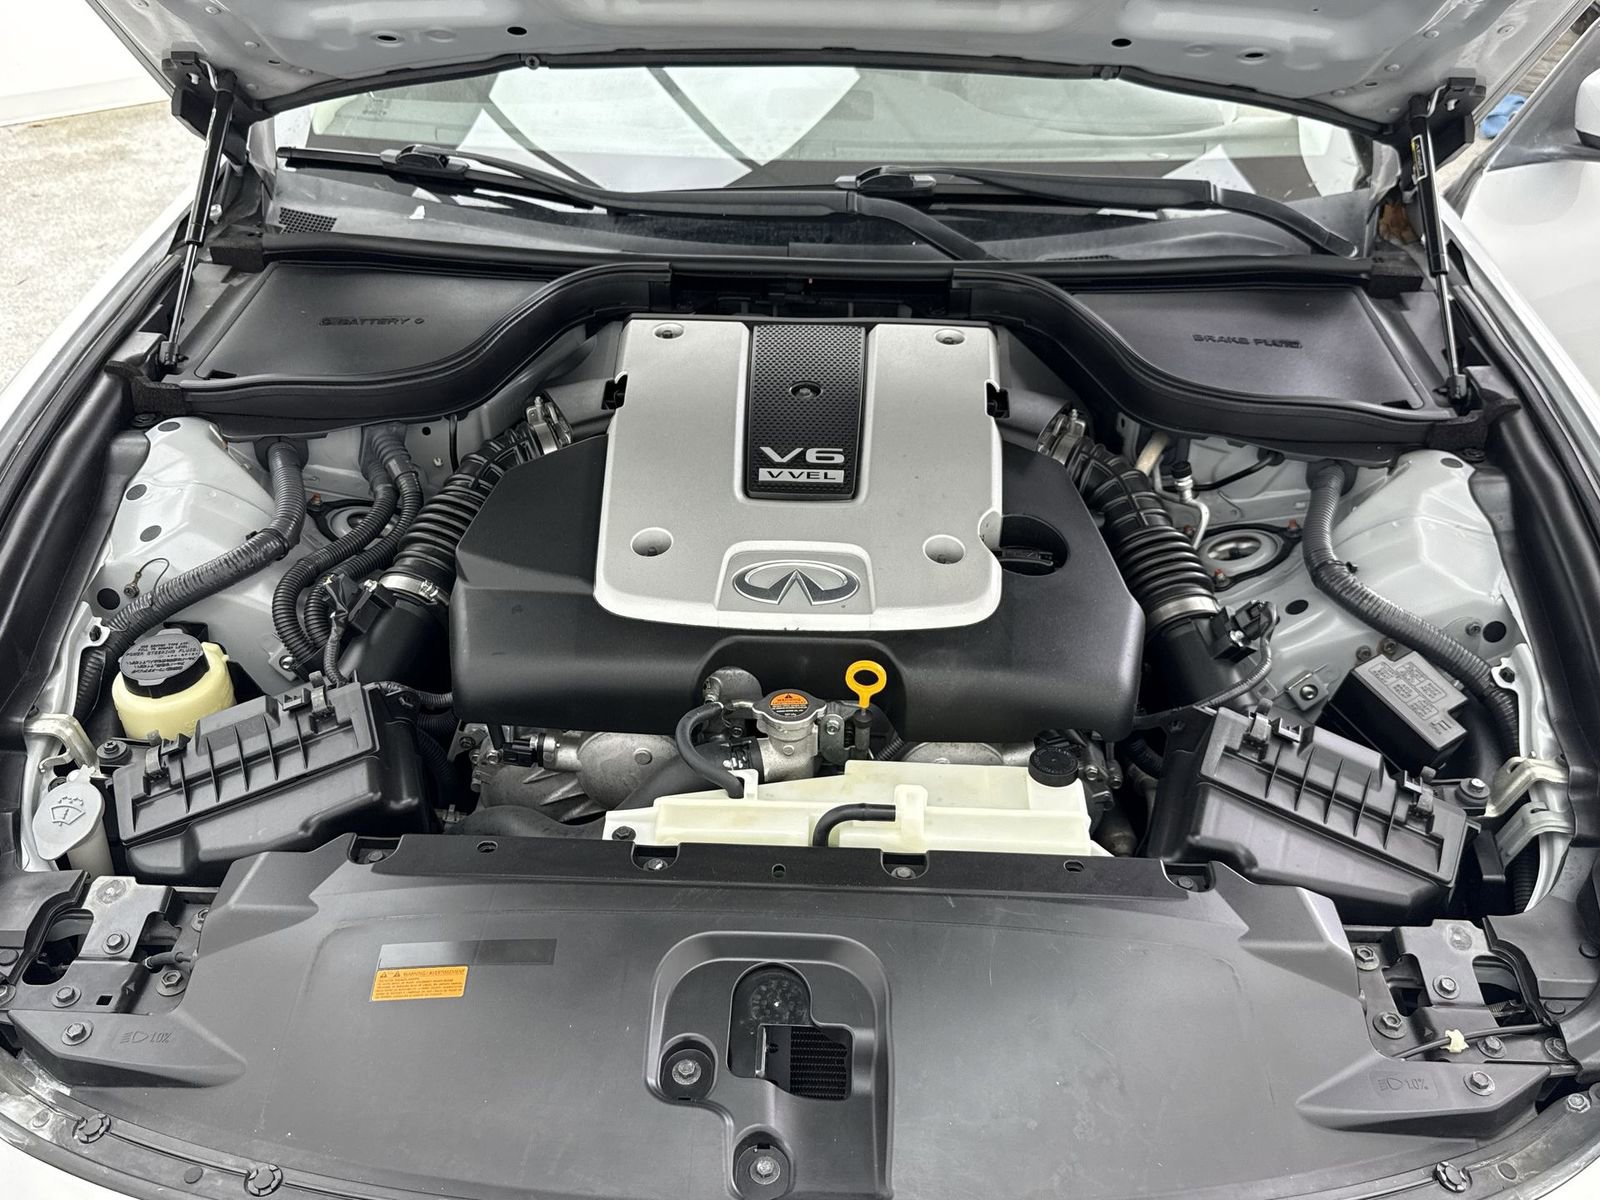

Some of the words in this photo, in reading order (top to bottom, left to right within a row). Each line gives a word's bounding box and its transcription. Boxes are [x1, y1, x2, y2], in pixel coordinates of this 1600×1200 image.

[1192, 334, 1250, 345] BRAKE
[759, 446, 845, 464] V6
[766, 470, 837, 481] VVEL
